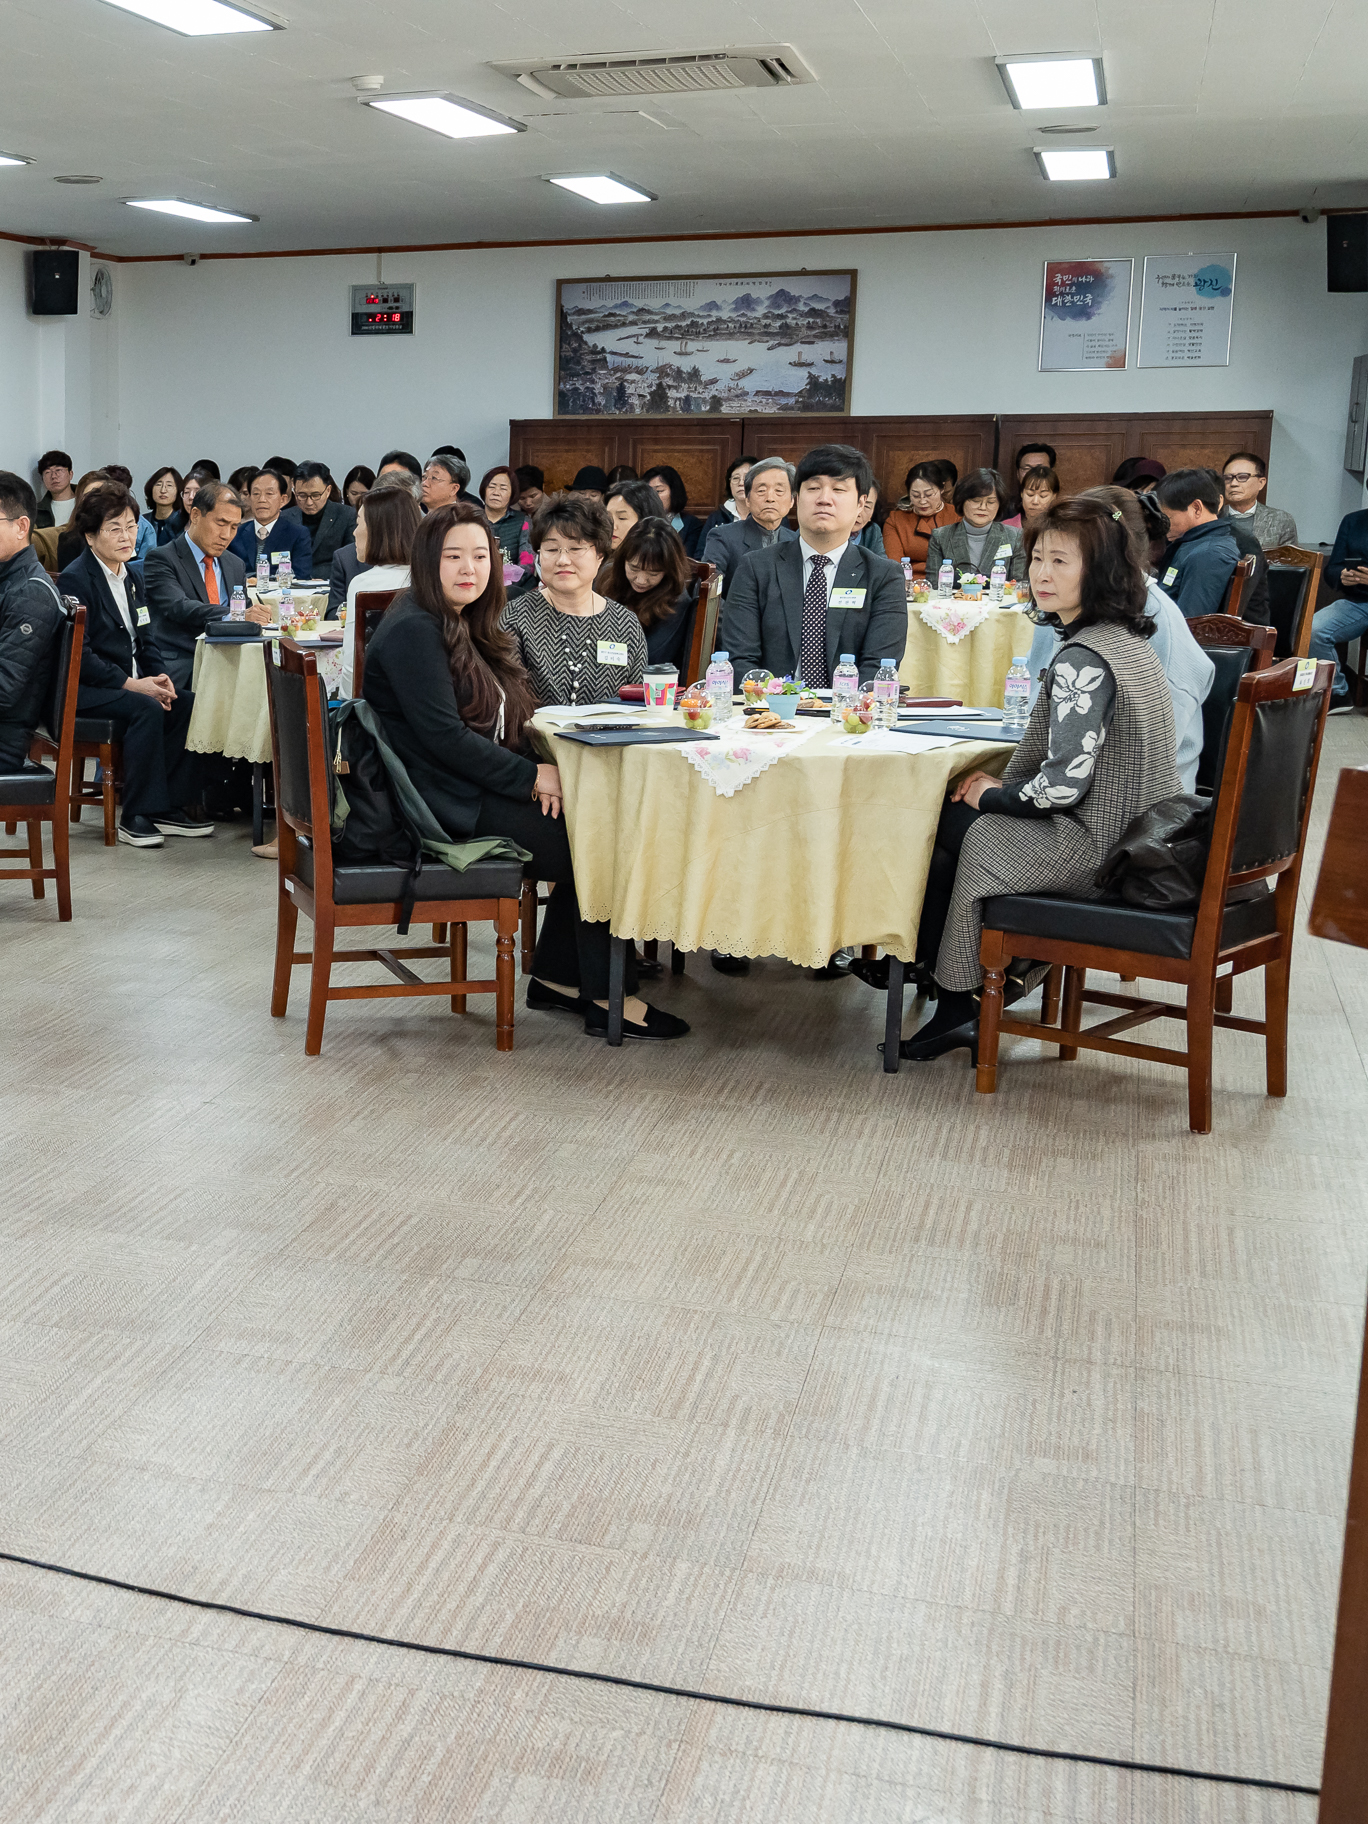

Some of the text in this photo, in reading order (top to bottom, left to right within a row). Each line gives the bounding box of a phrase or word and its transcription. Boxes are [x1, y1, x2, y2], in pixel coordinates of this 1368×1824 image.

[1053, 273, 1095, 285] 국민의 나라
[1193, 277, 1223, 291] 광진
[1052, 294, 1093, 306] 대한민국
